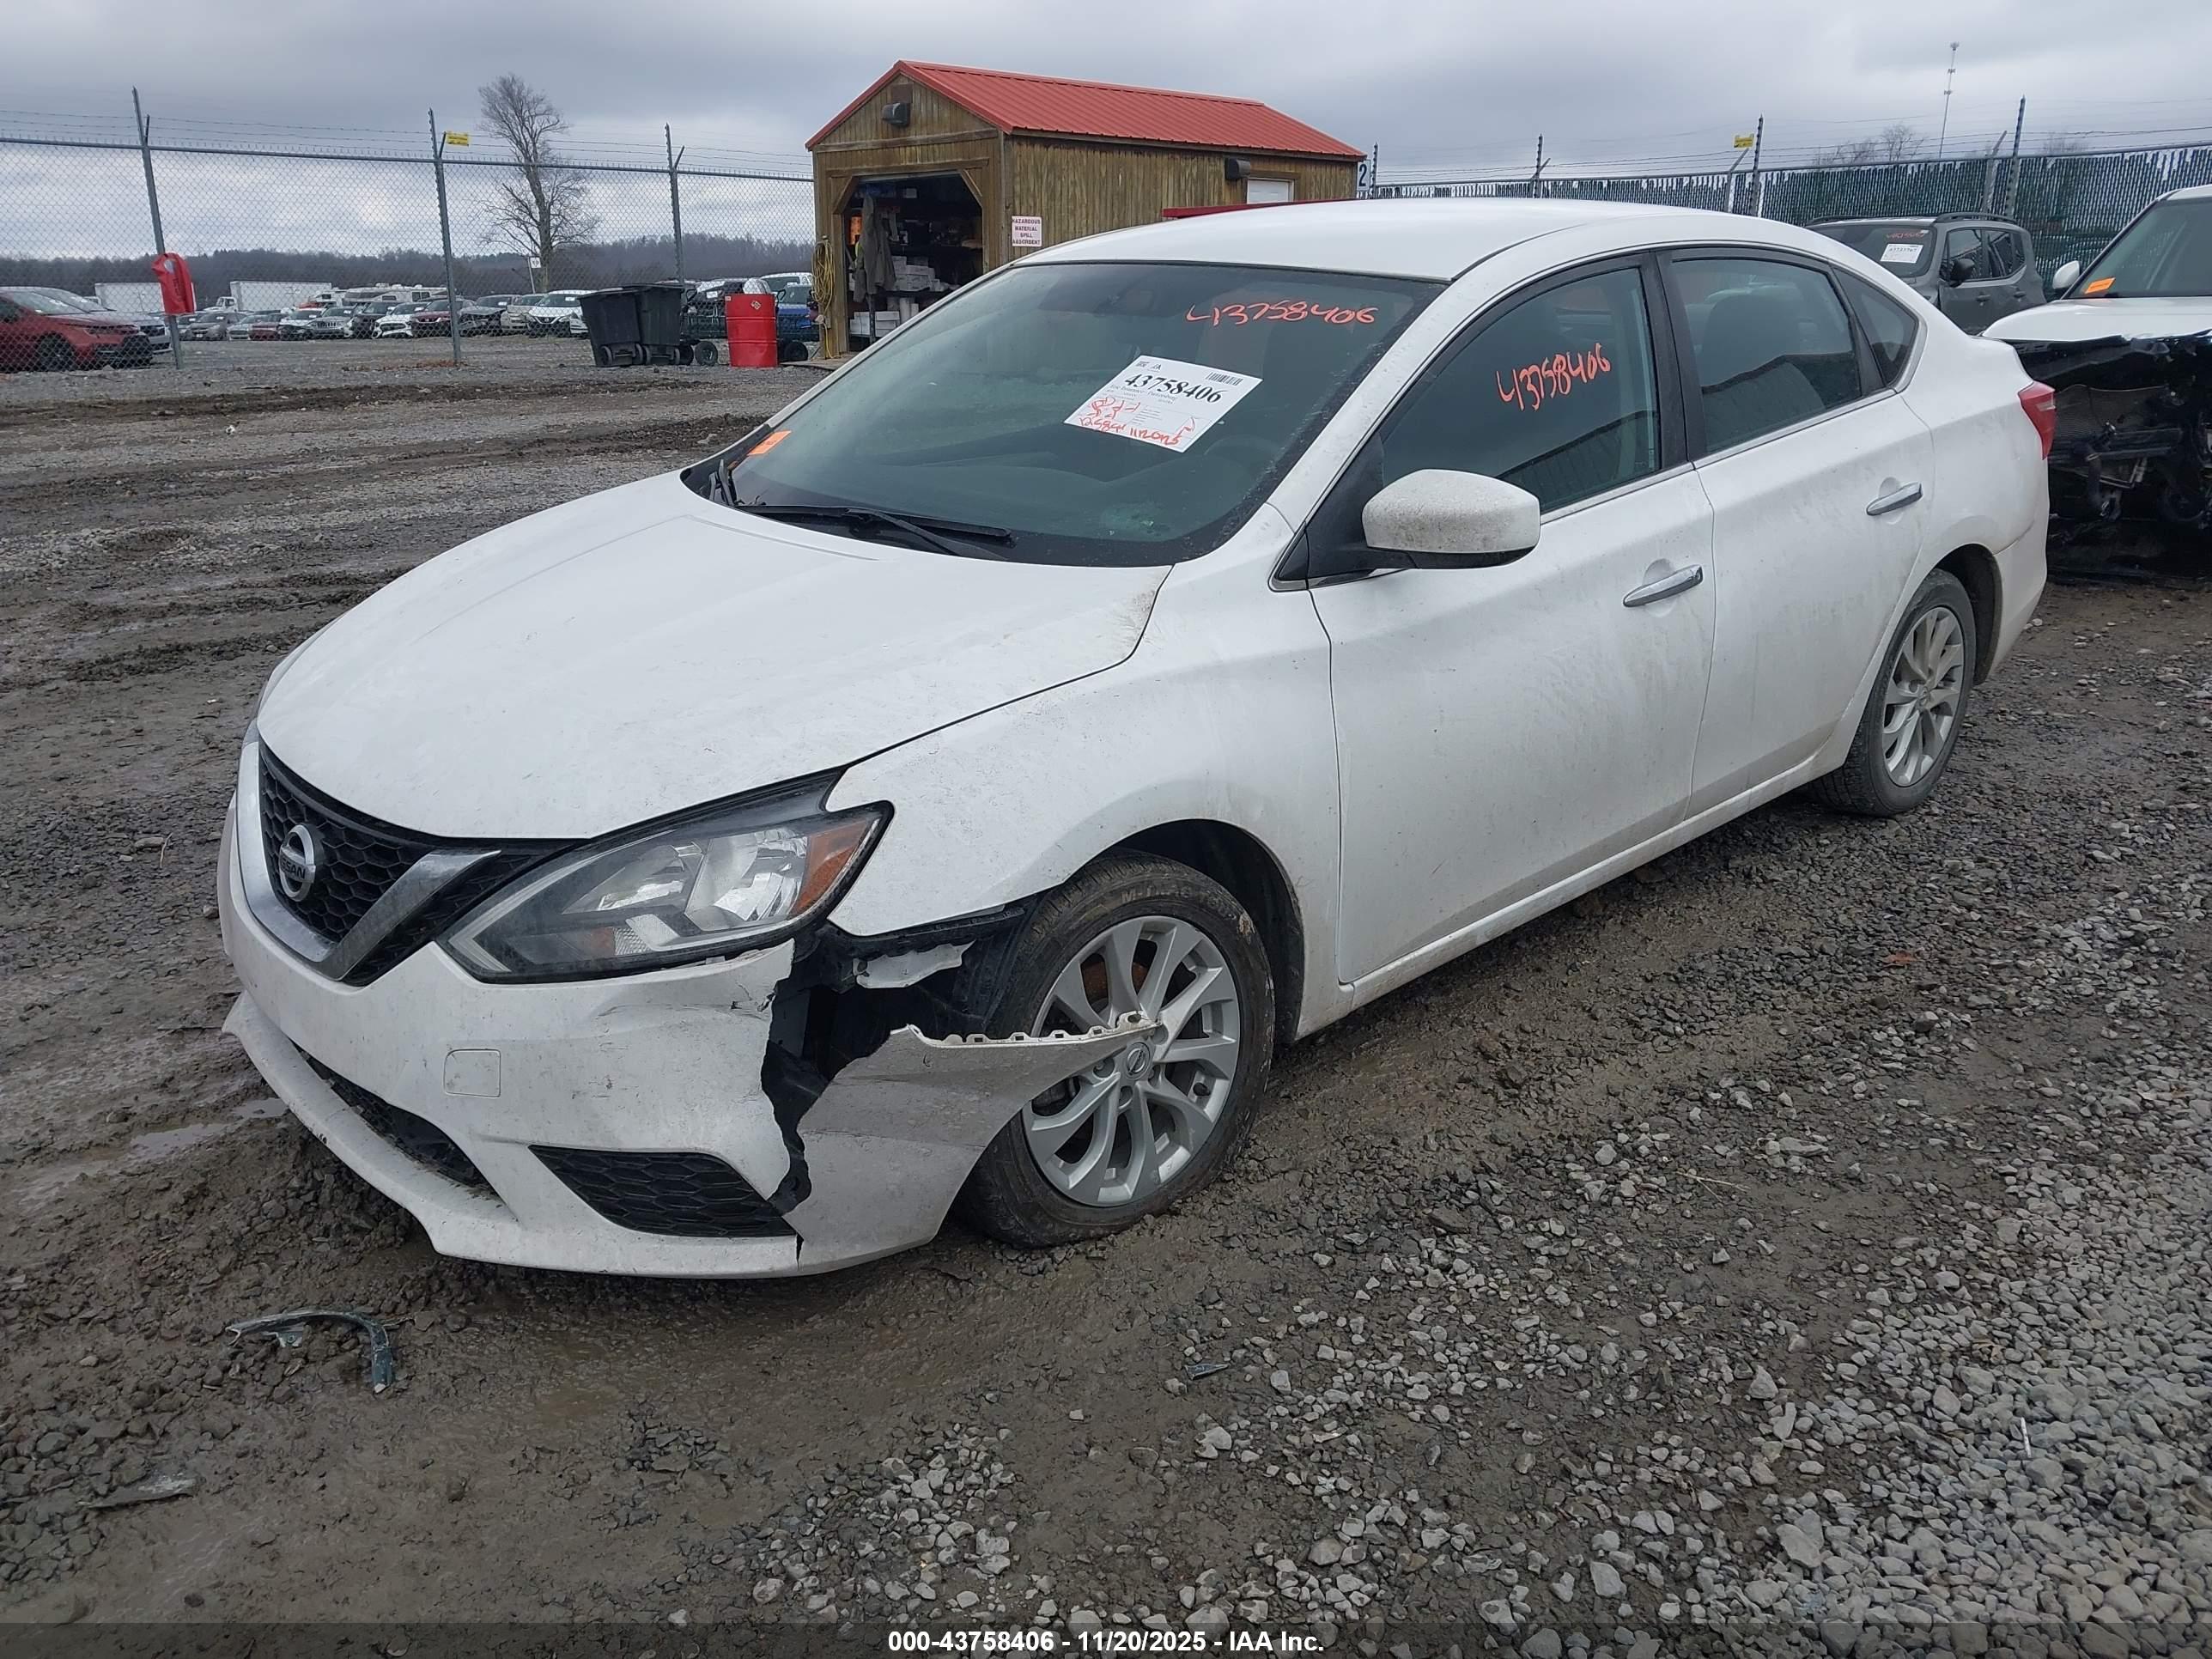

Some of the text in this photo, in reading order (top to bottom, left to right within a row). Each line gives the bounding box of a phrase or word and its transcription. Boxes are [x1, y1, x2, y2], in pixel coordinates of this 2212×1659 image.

[1186, 300, 1380, 326] 43758406
[1124, 374, 1228, 403] 43758406
[1496, 343, 1611, 411] 43758406
